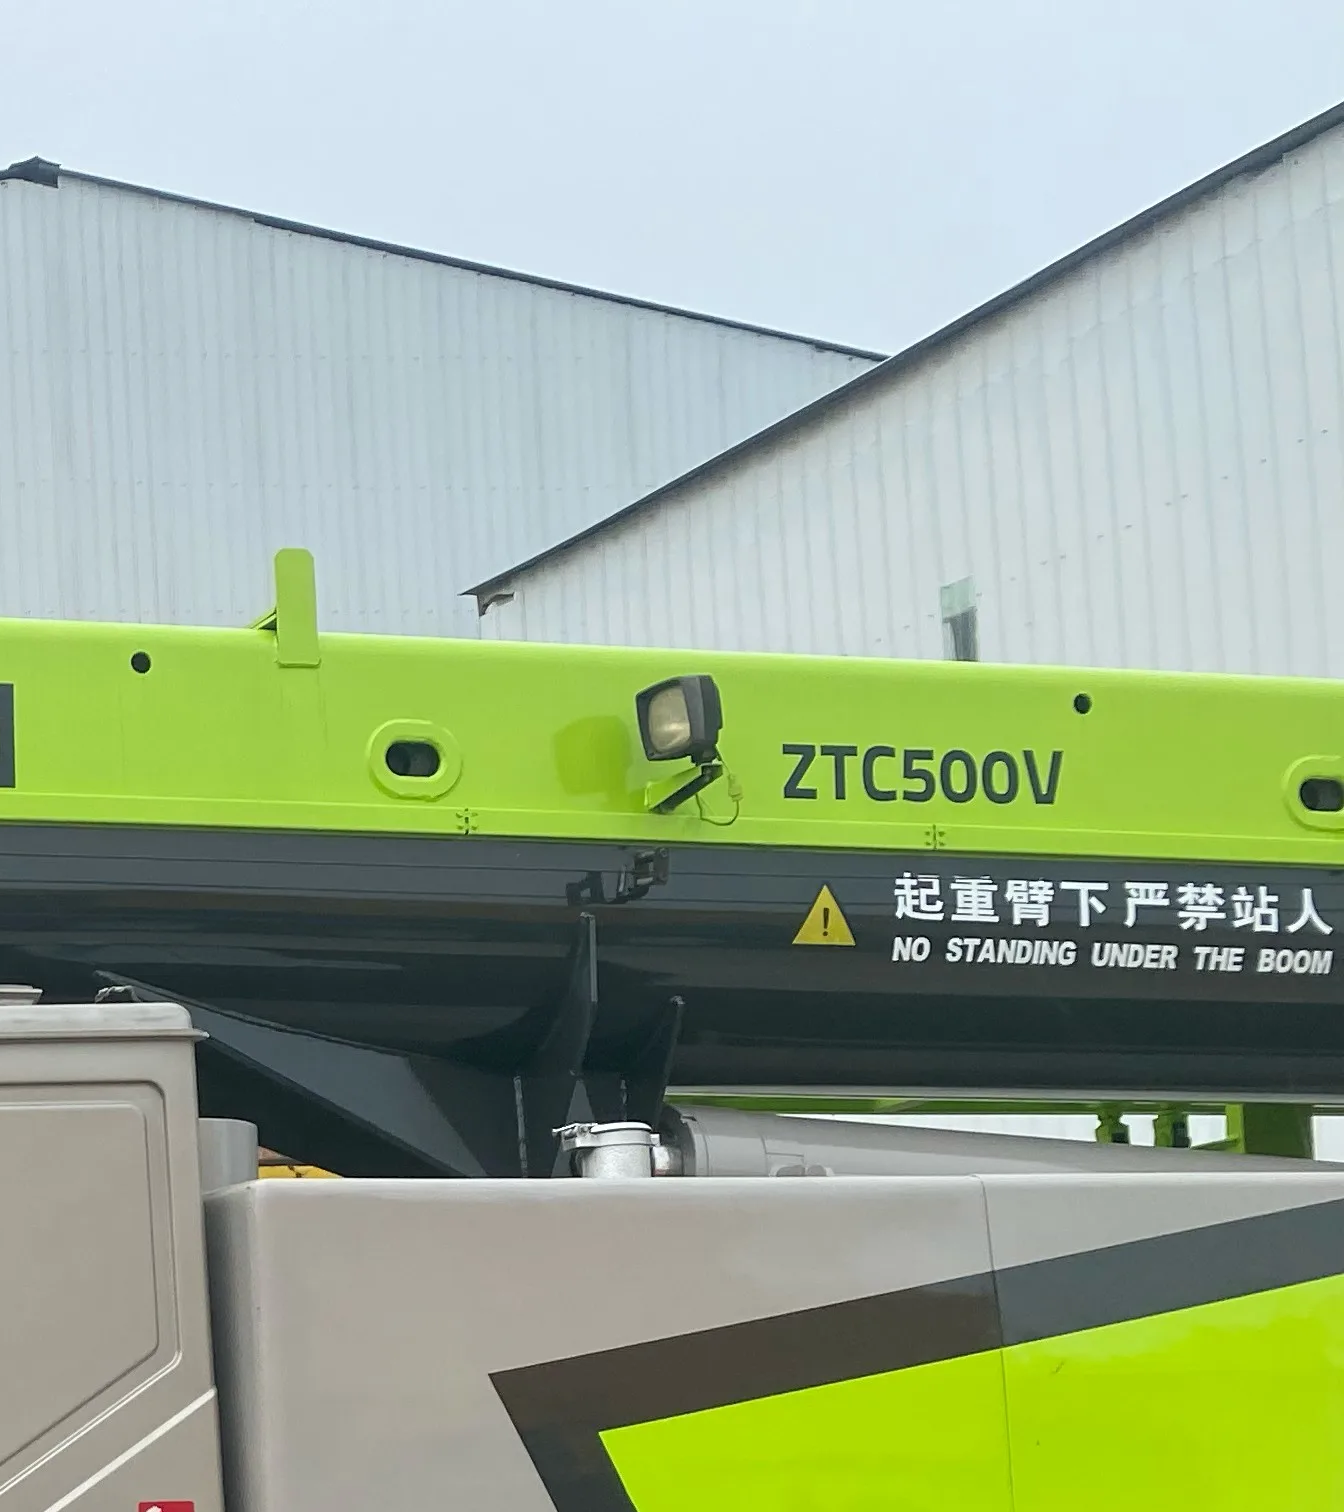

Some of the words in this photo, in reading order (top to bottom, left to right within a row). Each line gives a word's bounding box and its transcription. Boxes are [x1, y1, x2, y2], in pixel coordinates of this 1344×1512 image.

[782, 743, 1064, 805] ZTC500V
[893, 871, 1334, 936] 起重臂下严禁站人
[891, 936, 931, 962] NO
[945, 937, 1077, 966] STANDING
[1091, 942, 1178, 970] UNDER
[1193, 946, 1245, 972] THE
[1256, 948, 1334, 975] BOOM
